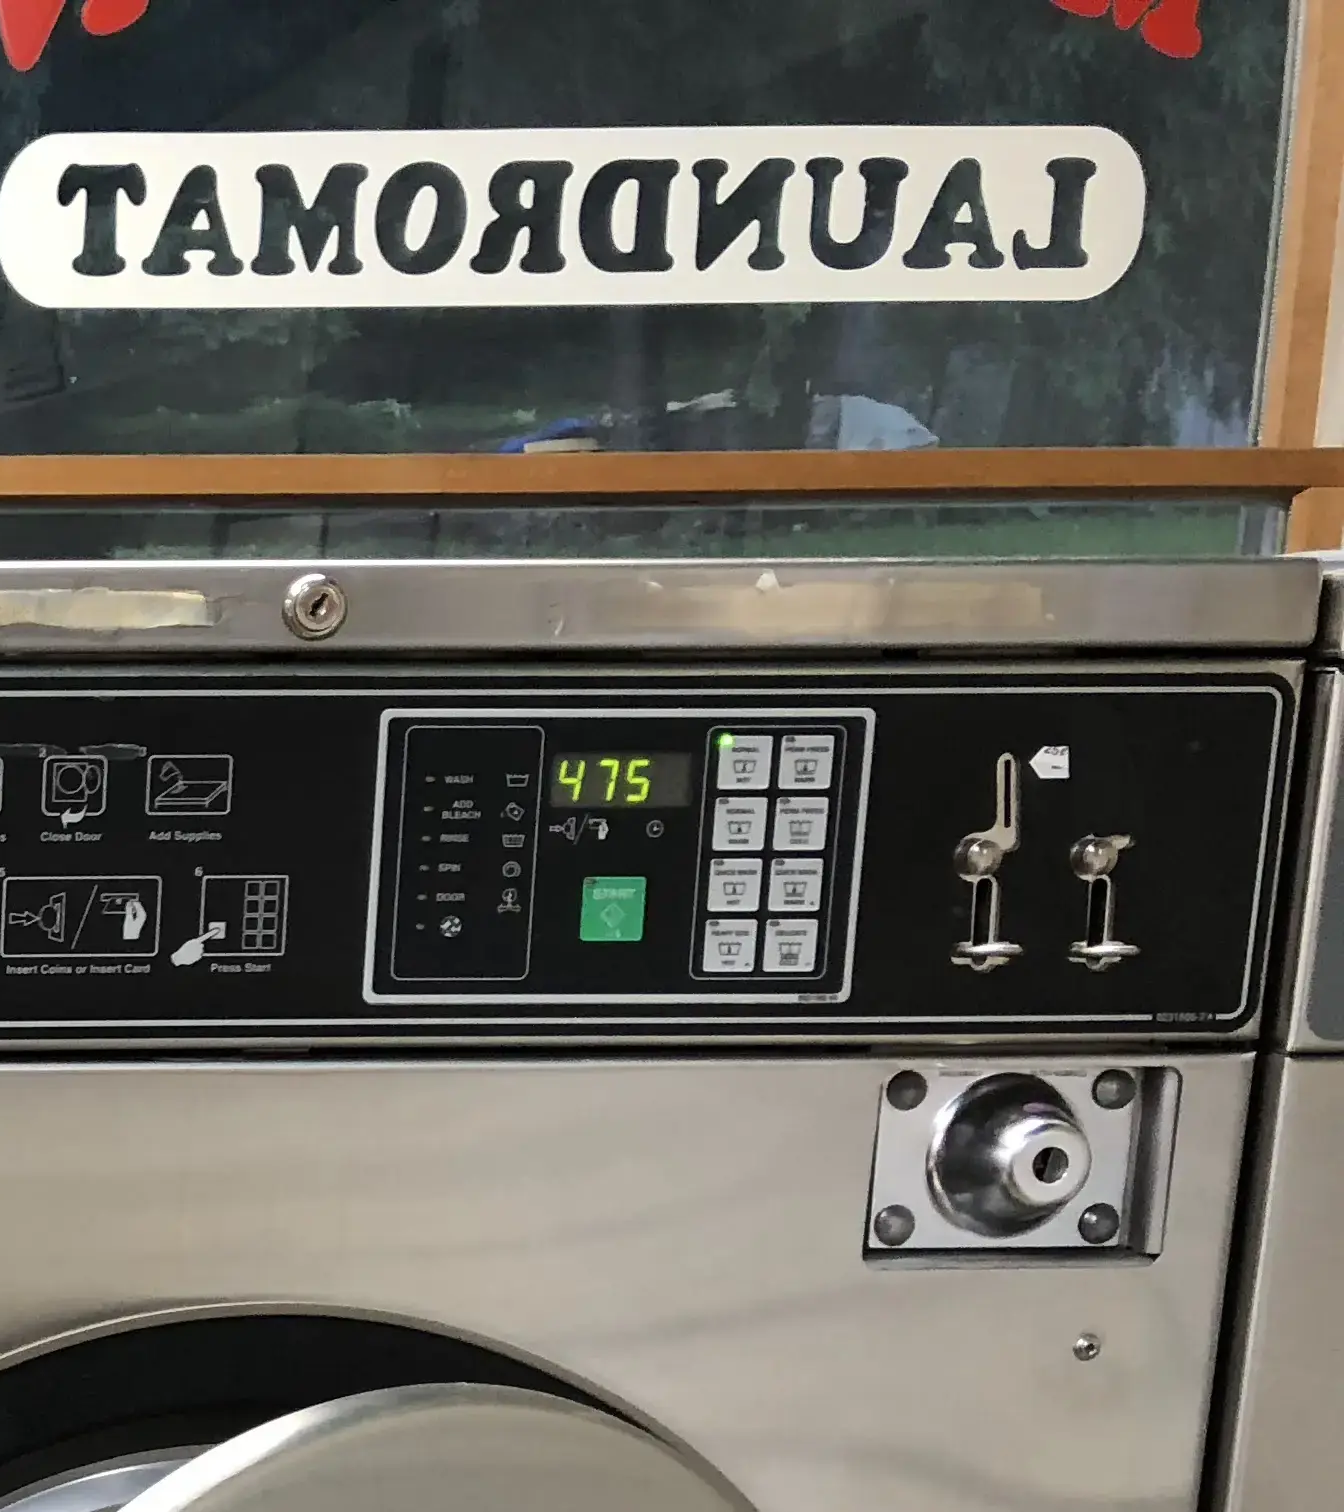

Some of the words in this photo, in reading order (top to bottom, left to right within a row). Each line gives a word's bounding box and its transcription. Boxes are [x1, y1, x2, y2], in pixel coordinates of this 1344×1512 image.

[444, 775, 474, 784] WASH
[558, 758, 651, 802] 475
[452, 800, 473, 809] ADD
[441, 810, 481, 819] BLEACH
[40, 831, 72, 842] Close
[75, 831, 102, 842] Door
[149, 831, 171, 841] Add
[174, 831, 222, 843] Supplies
[592, 888, 636, 900] START
[6, 964, 37, 975] Insert
[40, 964, 72, 975] Coins
[75, 966, 86, 975] or
[90, 964, 120, 974] Insert
[124, 963, 150, 974] Card
[211, 963, 241, 973] Press
[244, 963, 271, 973] Start
